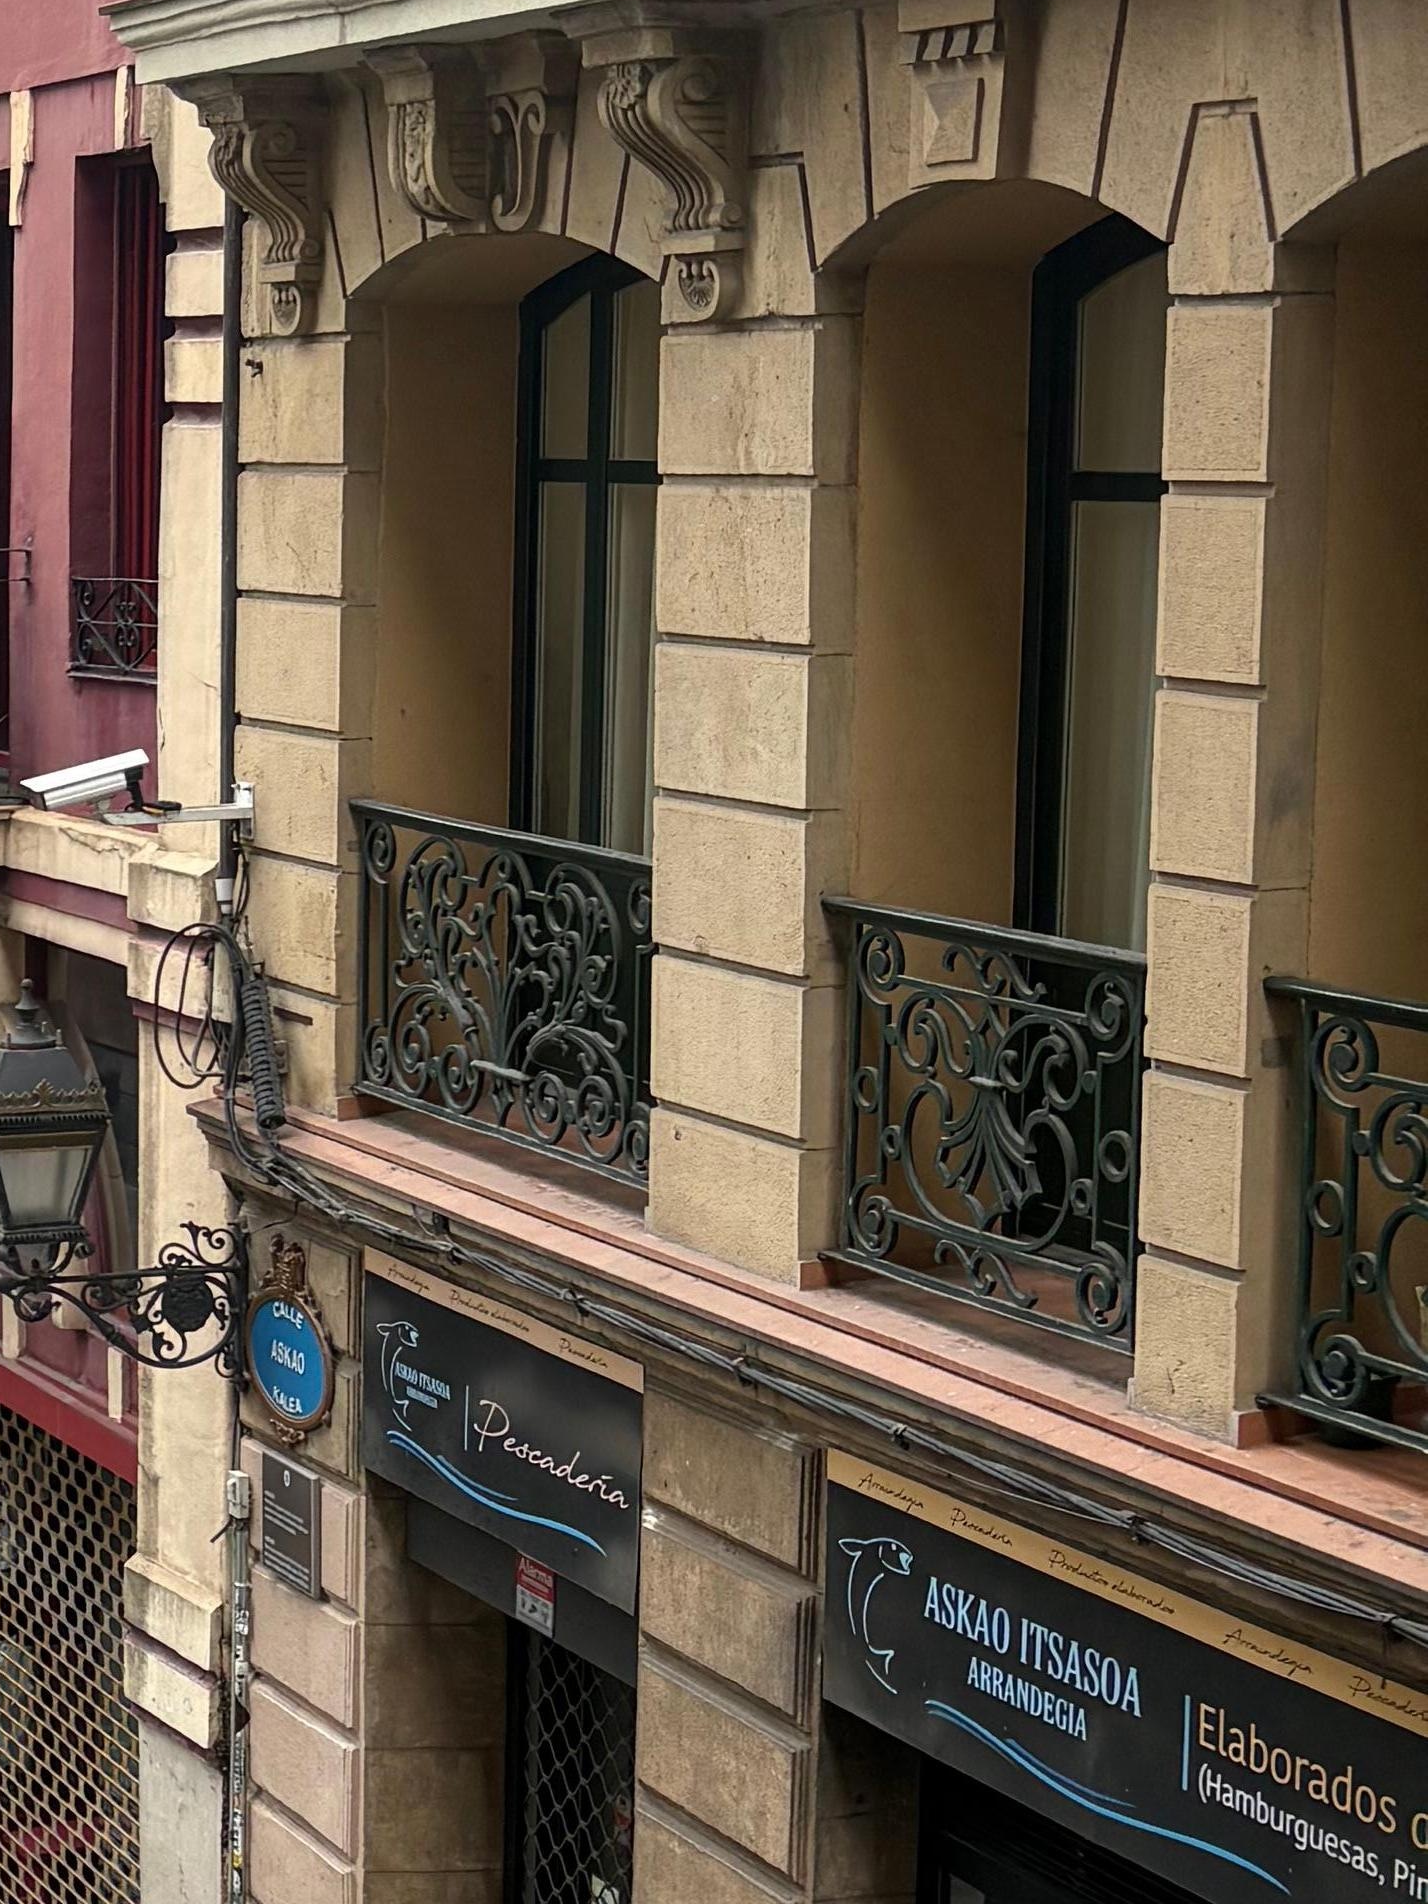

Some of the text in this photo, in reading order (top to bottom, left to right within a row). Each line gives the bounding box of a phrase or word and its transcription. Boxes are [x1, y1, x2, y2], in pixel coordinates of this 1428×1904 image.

[270, 1339, 305, 1375] ASKAO
[272, 1300, 304, 1330] CALLE
[271, 1385, 304, 1414] KALEA
[473, 1400, 630, 1510] Pescadería
[923, 1576, 1142, 1718] ASKAO ITSASOA
[967, 1656, 1087, 1742] ARRANDEGIA
[1198, 1702, 1397, 1834] Elaborados
[1197, 1763, 1385, 1886] (Hamburguesas,
